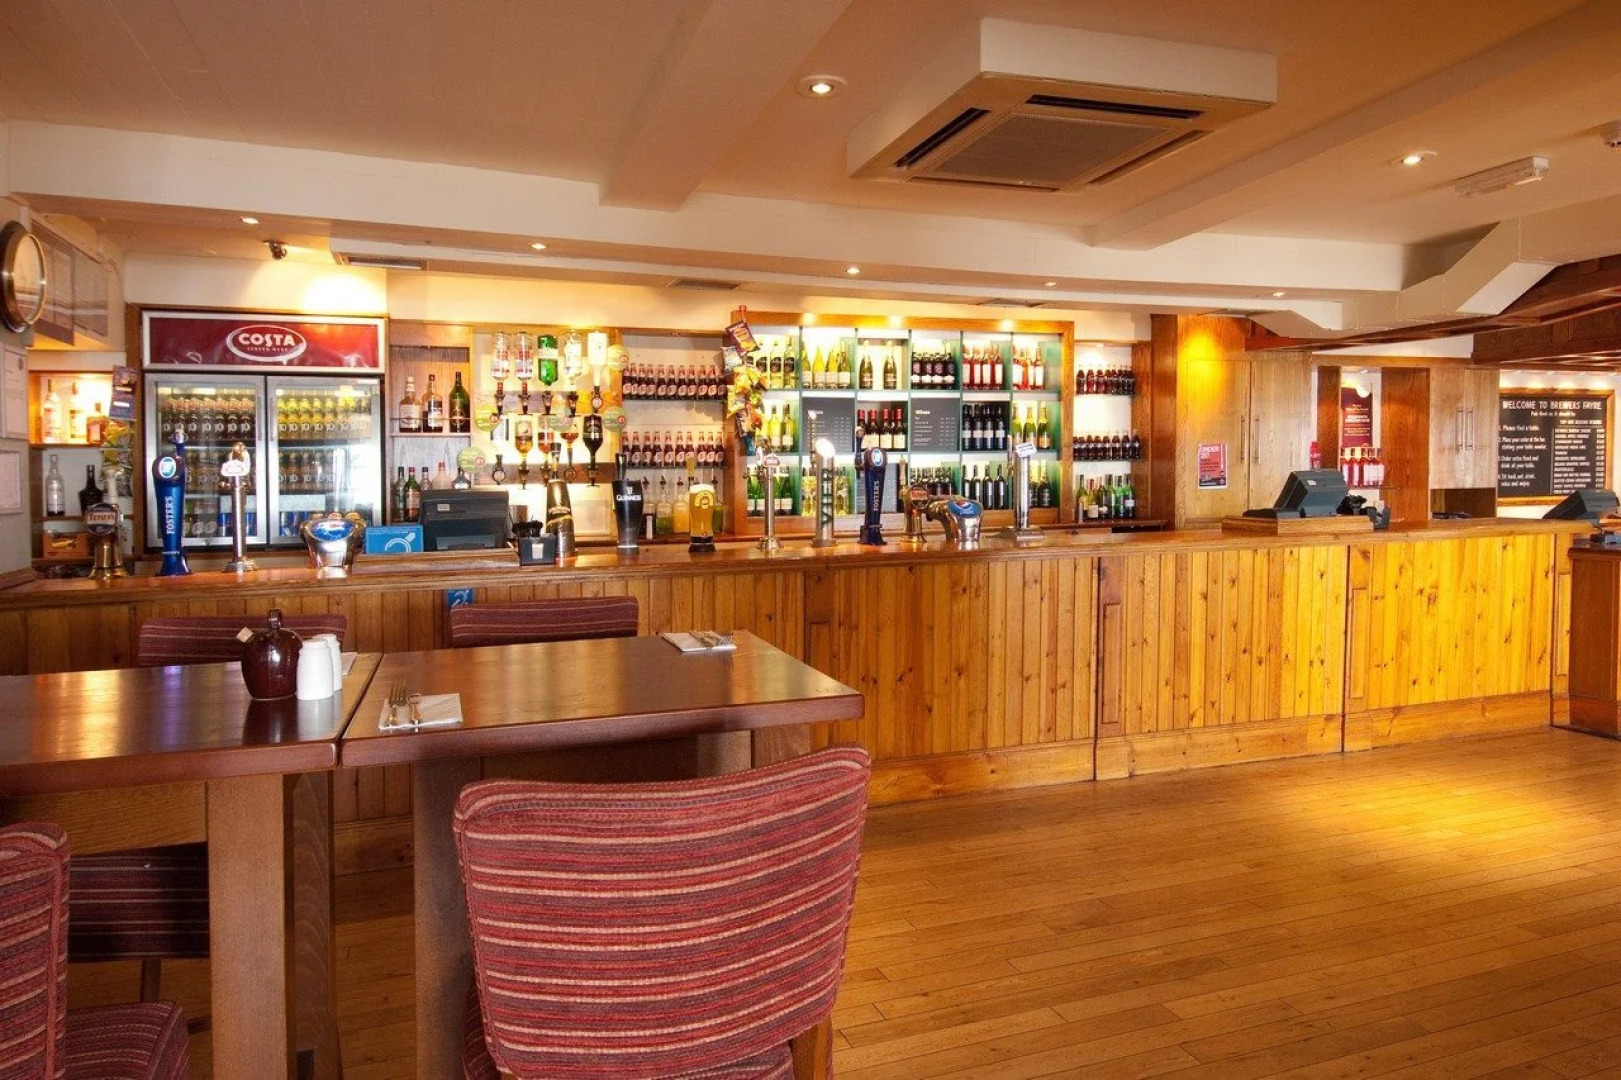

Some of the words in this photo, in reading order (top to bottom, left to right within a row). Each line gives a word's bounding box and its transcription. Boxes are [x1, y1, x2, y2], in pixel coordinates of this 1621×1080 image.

[238, 333, 296, 347] COSTA
[1502, 400, 1536, 409] WELCOME
[1539, 400, 1548, 409] TO
[1550, 400, 1580, 409] BREWERS
[1583, 400, 1602, 410] FAYRE
